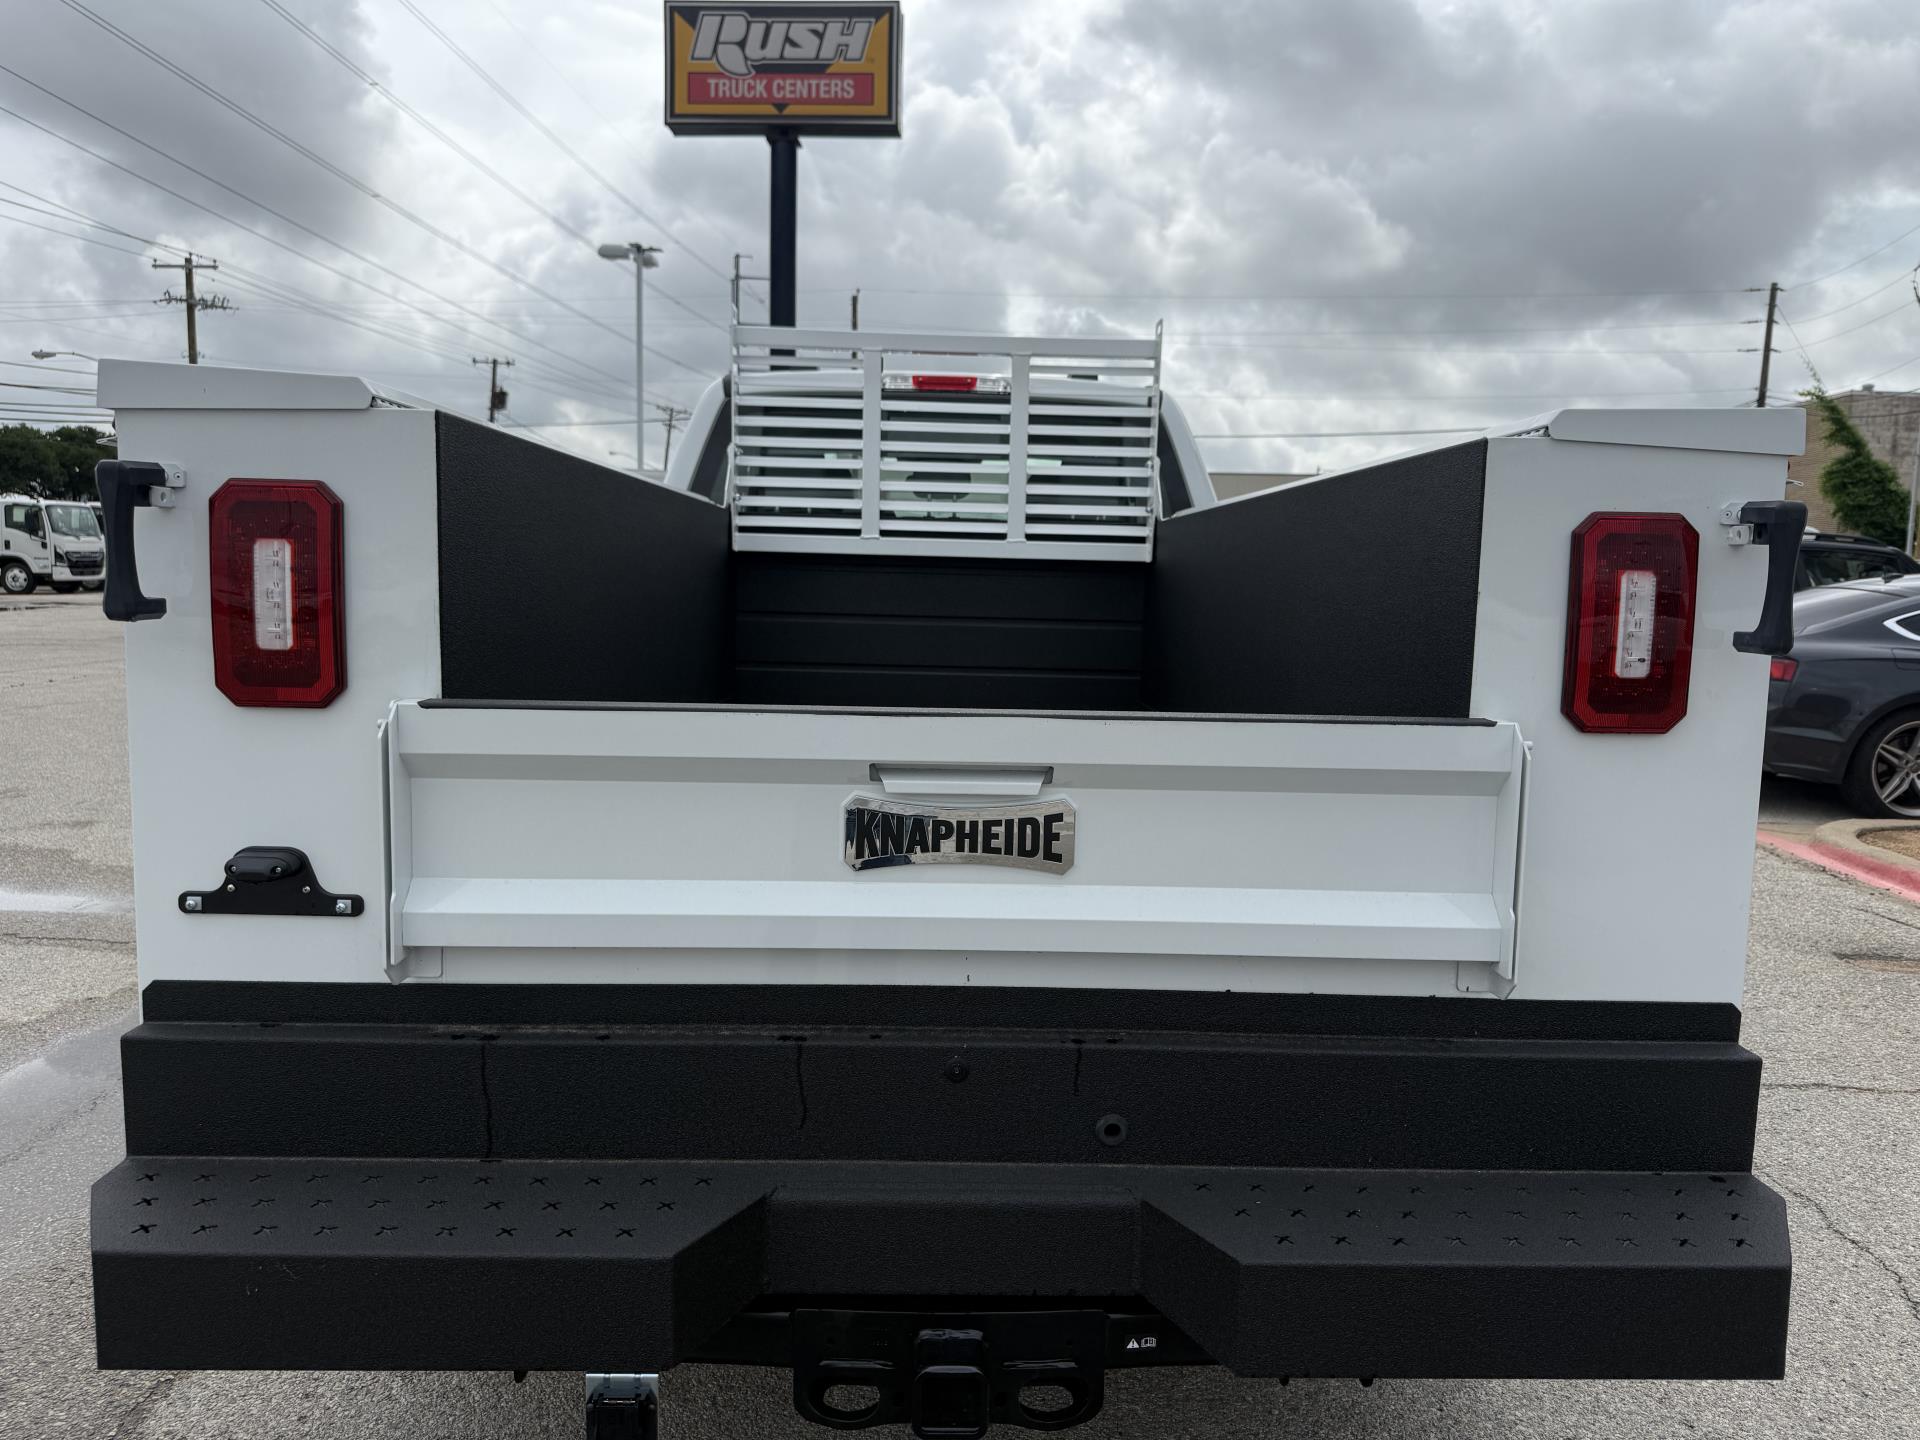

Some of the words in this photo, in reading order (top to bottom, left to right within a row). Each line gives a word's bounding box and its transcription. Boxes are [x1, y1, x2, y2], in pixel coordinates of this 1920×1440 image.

[690, 12, 875, 76] RUSH
[707, 78, 768, 98] TRUCK
[772, 79, 855, 99] CENTERS
[855, 807, 1064, 864] KNAPHEIDE
